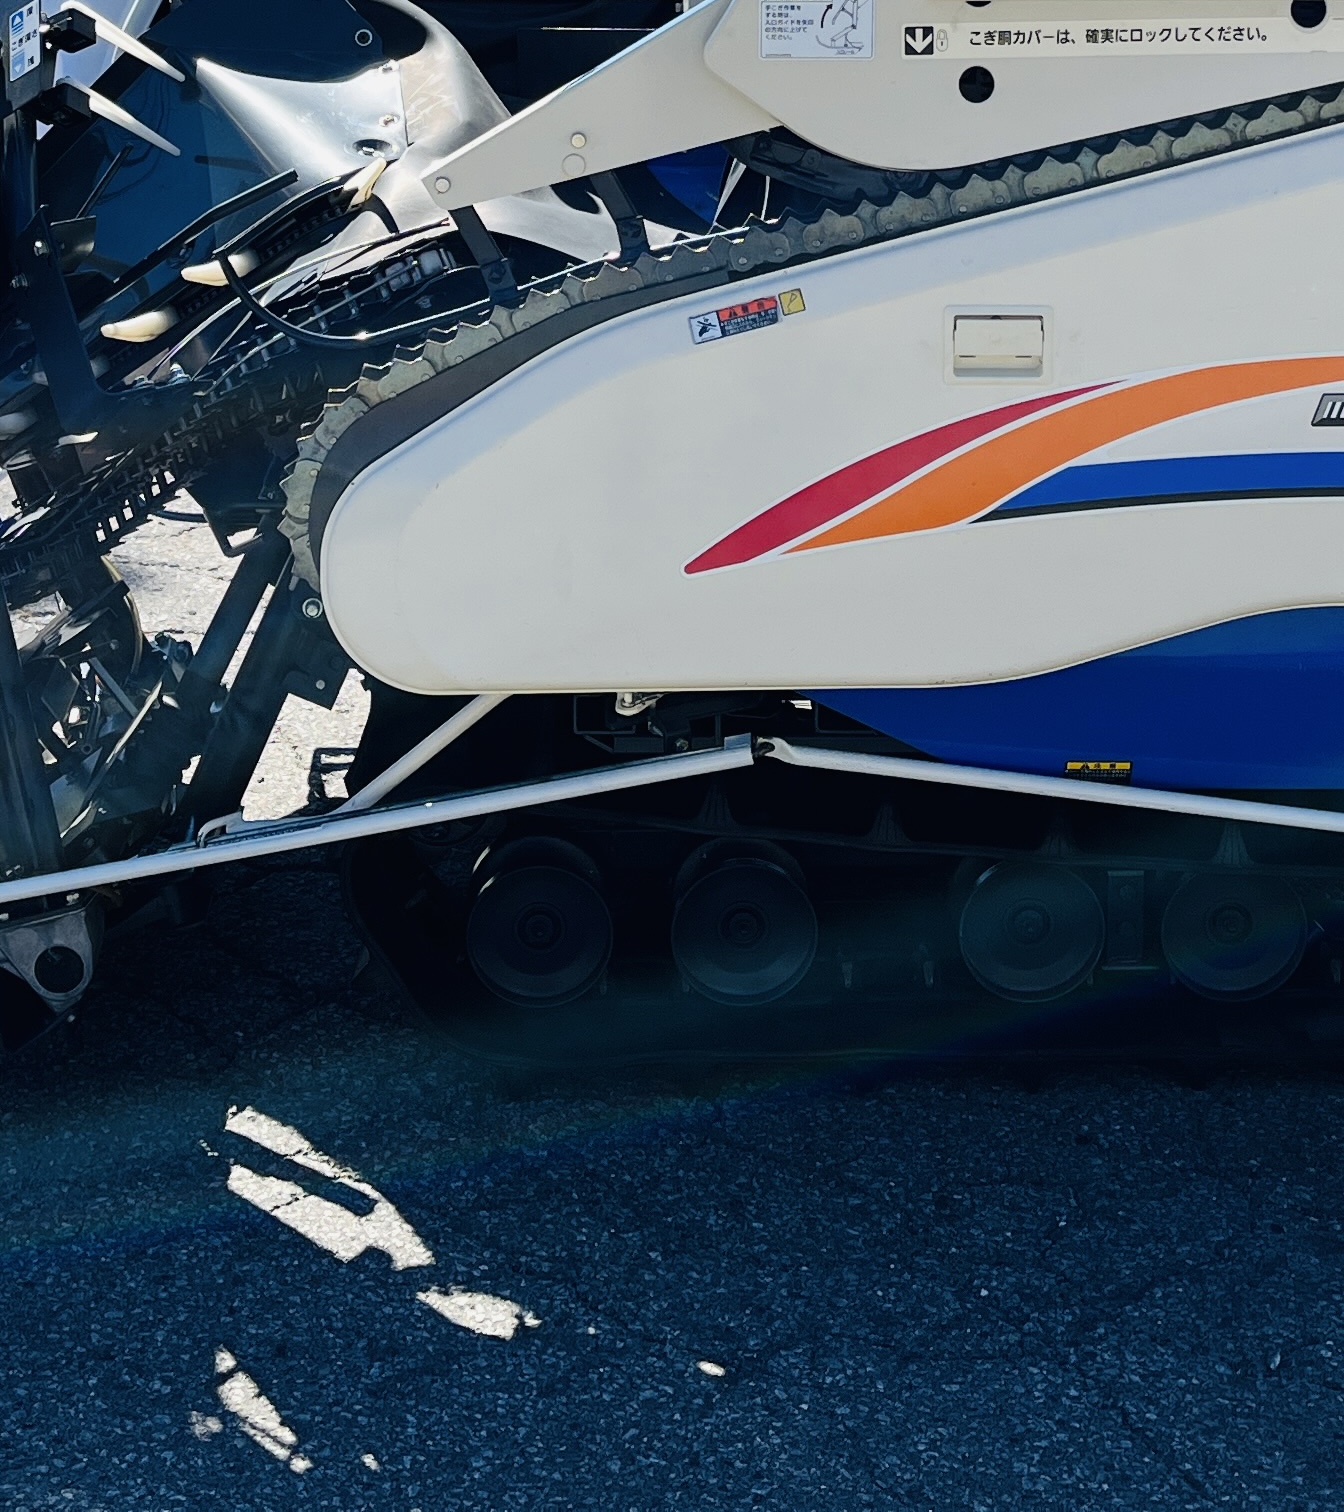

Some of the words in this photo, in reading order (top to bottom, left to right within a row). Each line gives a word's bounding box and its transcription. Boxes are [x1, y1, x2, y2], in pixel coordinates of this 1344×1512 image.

[968, 26, 1268, 46] こぎ胴カバーは、確実にロックしてください。
